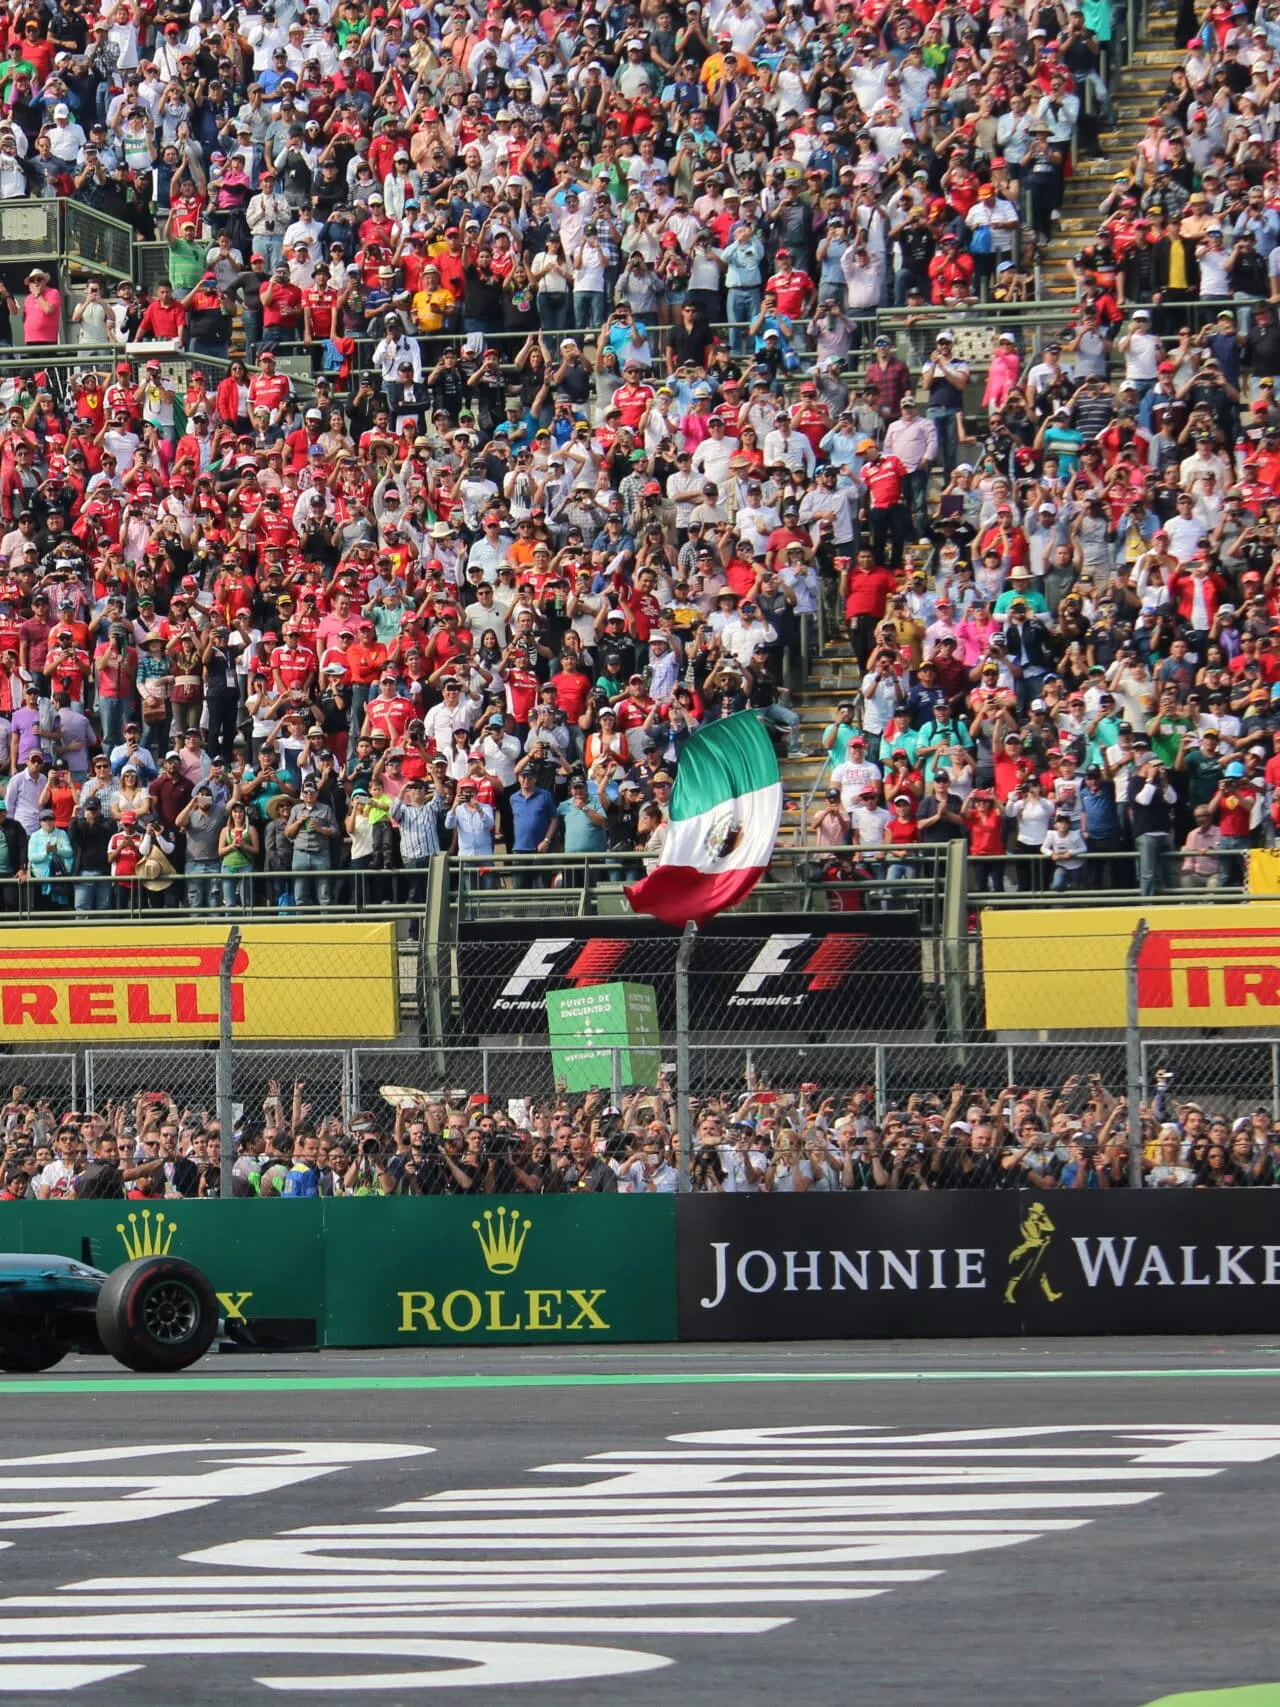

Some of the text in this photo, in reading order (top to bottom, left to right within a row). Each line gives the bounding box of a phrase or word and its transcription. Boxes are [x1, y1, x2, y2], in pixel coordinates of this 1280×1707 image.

[492, 997, 548, 1010] Formul
[727, 995, 791, 1007] Formula
[561, 1003, 612, 1018] ENCUENTRO
[700, 1242, 987, 1309] JOHNNIE
[397, 1288, 610, 1332] ROLEX
